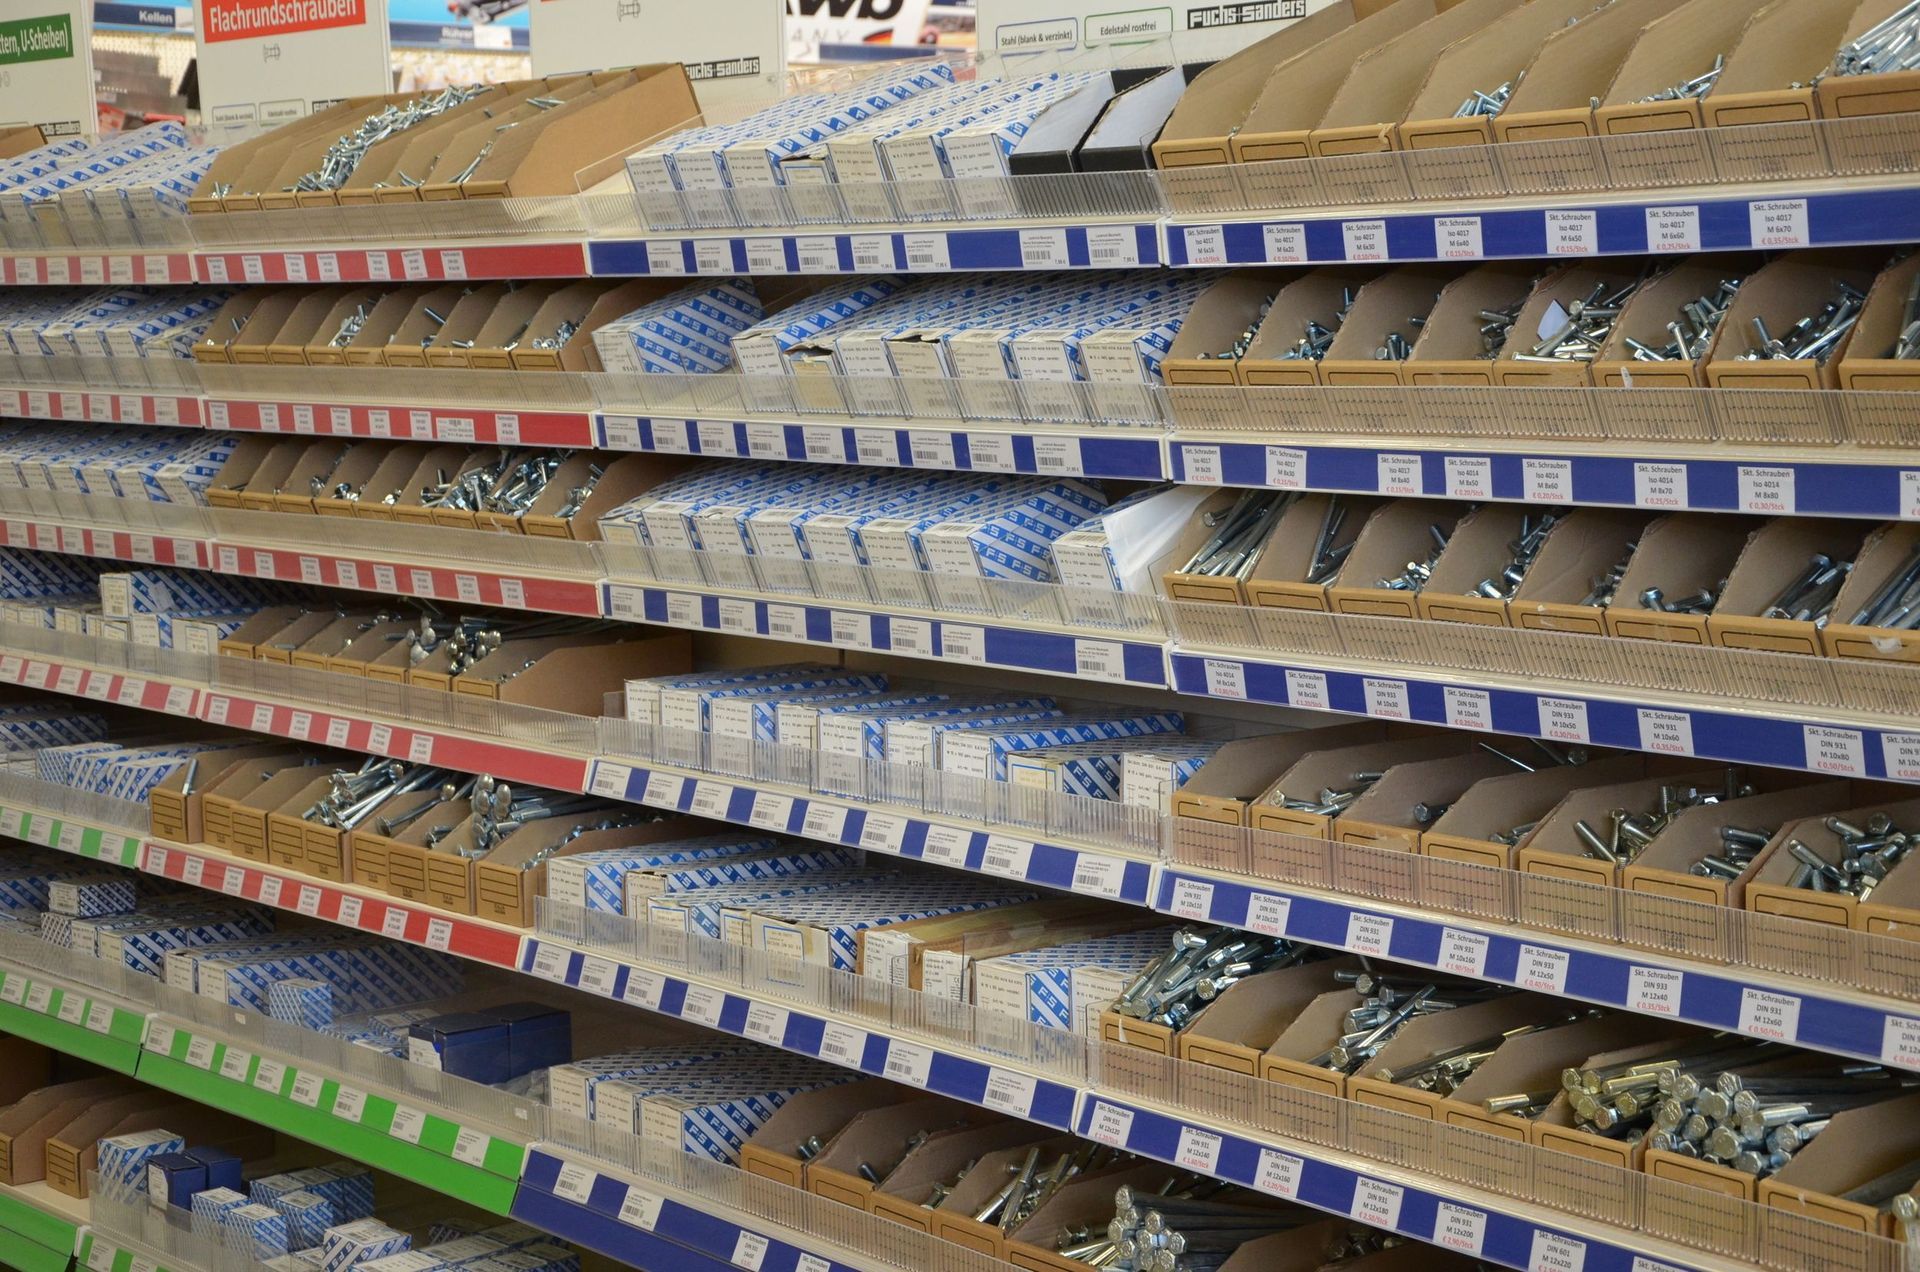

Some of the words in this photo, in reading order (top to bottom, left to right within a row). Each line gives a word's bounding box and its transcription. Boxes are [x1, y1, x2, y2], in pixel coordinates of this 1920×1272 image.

[138, 10, 173, 23] Kellen
[210, 0, 356, 33] Flachrundschrauben
[1100, 23, 1129, 36] Edelstahl
[1130, 20, 1157, 34] rostfrei
[21, 23, 69, 52] U-Scheiben)
[1001, 36, 1016, 46] Stahl
[1017, 34, 1037, 46] (blank
[1038, 33, 1044, 43] &
[1045, 29, 1073, 43] verzinkt)
[1767, 202, 1802, 210] Schrauben
[1662, 209, 1694, 217] Schrauben
[1775, 213, 1791, 221] 4017
[1669, 220, 1684, 228] 4017
[1650, 465, 1682, 473] Schrauben
[1763, 480, 1779, 488] 4014
[1762, 491, 1778, 499] 8x80
[1553, 701, 1582, 709] Schrauben
[1563, 711, 1574, 719] 933
[1654, 712, 1686, 721] Schrauben
[1559, 721, 1576, 729] 10x50
[1661, 733, 1679, 741] 10x60
[1822, 729, 1857, 739] Schrauben
[1820, 740, 1833, 748] DIN
[1834, 741, 1846, 749] 931
[1829, 752, 1849, 760] 10x80
[1453, 943, 1463, 951] DIN
[1536, 949, 1565, 960] Schrauben
[1532, 959, 1542, 967] DIN
[1543, 961, 1554, 969] 933
[1536, 971, 1553, 979] 12x50
[1647, 970, 1678, 980] Schrauben
[1643, 980, 1655, 988] DIN
[1656, 982, 1667, 990] 933
[1649, 992, 1667, 1000] 12x40
[1760, 993, 1794, 1006] Schrauben
[1756, 1004, 1768, 1012] DIN
[1769, 1006, 1781, 1015] 931
[1762, 1016, 1782, 1026] 12x60
[1274, 1152, 1299, 1164] Schrauben
[1270, 1161, 1280, 1169] DIN
[1371, 1182, 1398, 1196] Schrauben
[1367, 1192, 1377, 1200] DIN
[1454, 1206, 1483, 1218] Schrauben
[1450, 1215, 1461, 1224] DIN
